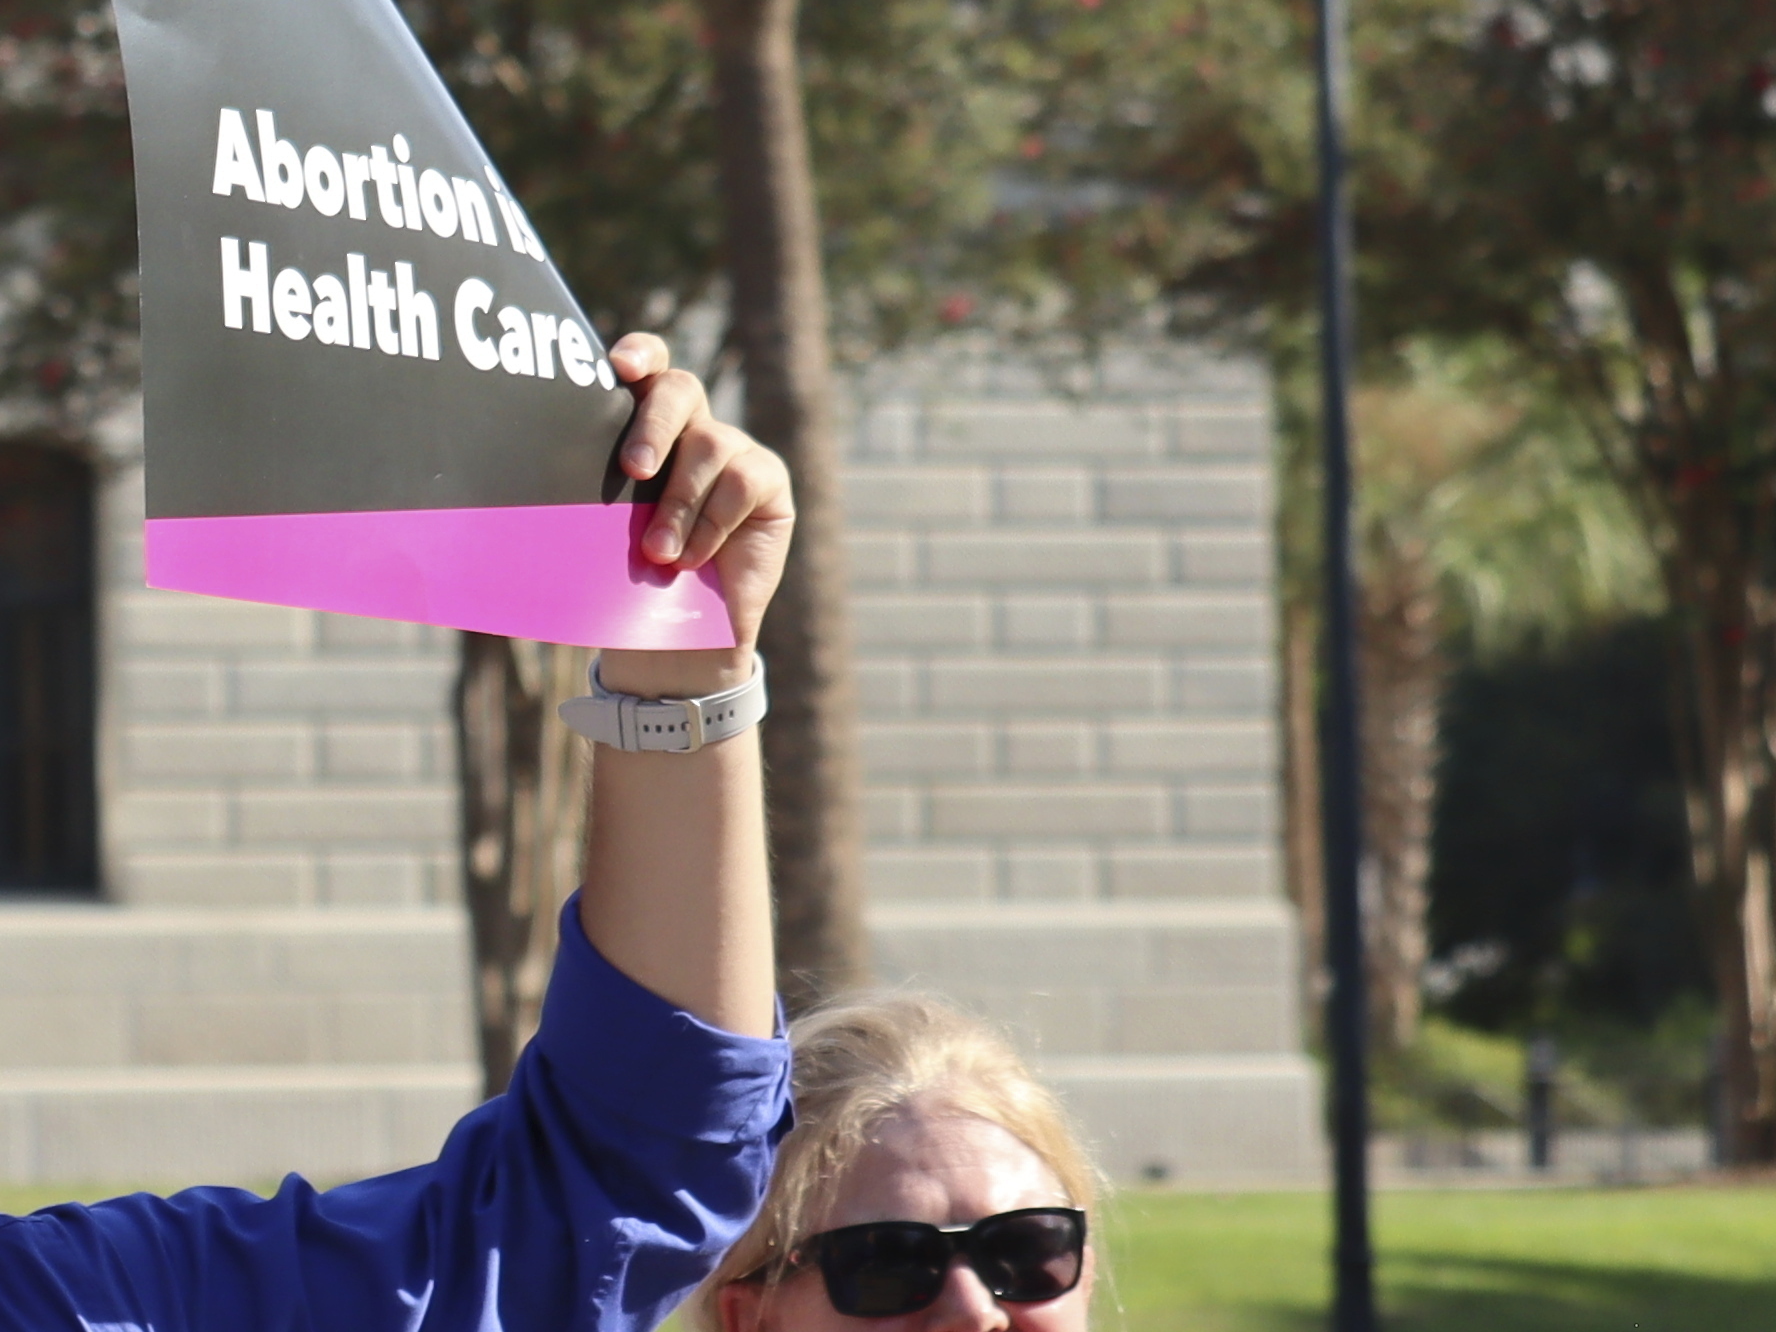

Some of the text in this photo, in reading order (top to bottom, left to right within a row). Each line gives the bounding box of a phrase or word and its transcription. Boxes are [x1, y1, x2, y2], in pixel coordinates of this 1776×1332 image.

[212, 107, 546, 263] Abortion is
[220, 236, 616, 391] Health Care.
